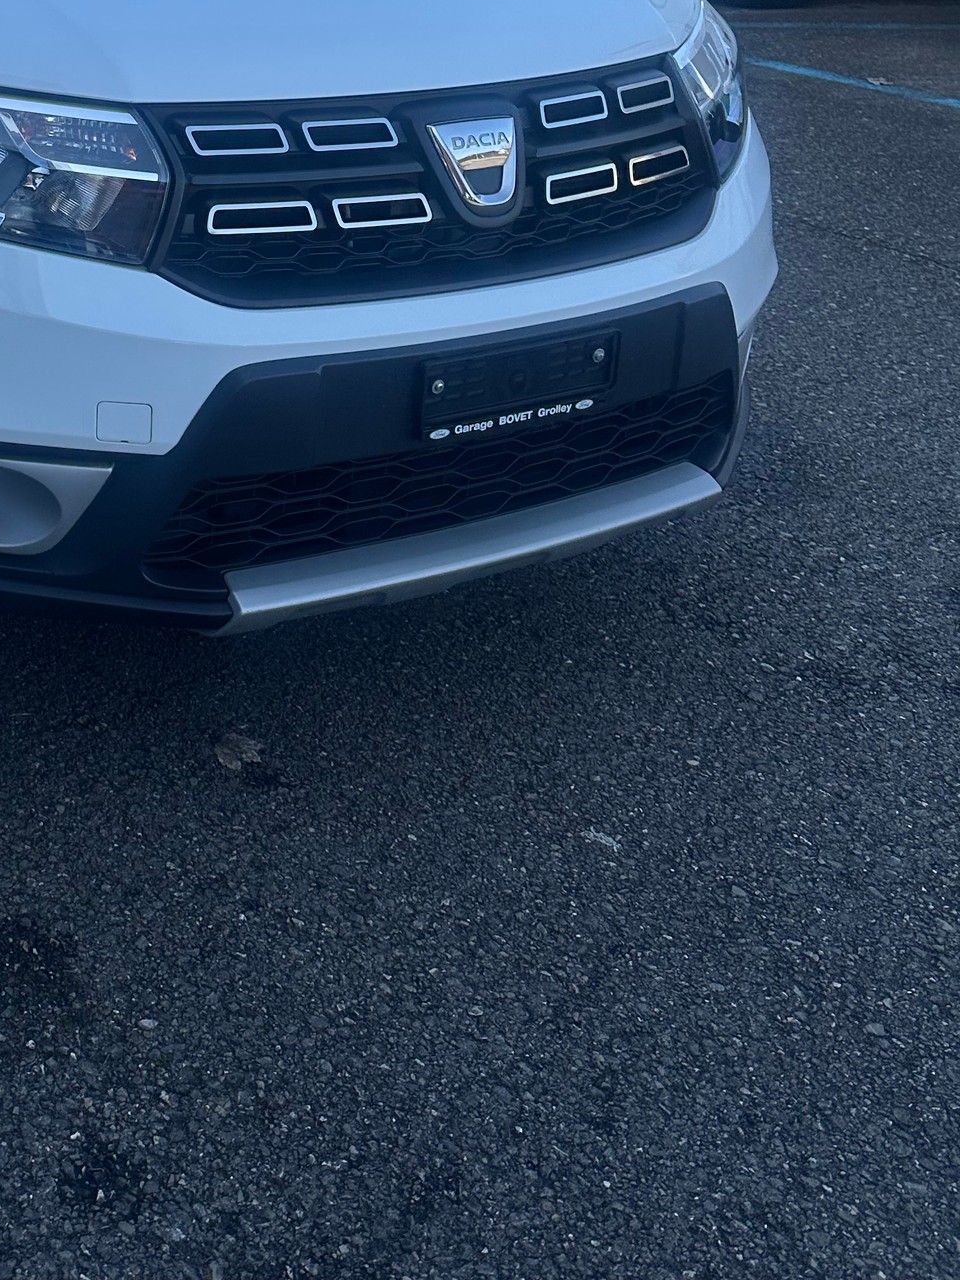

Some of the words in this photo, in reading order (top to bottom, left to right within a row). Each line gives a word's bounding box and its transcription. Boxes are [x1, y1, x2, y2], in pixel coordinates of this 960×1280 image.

[451, 131, 510, 151] DACIA
[454, 420, 494, 434] Garage
[499, 410, 533, 426] BOVET
[538, 403, 572, 417] Grolley
